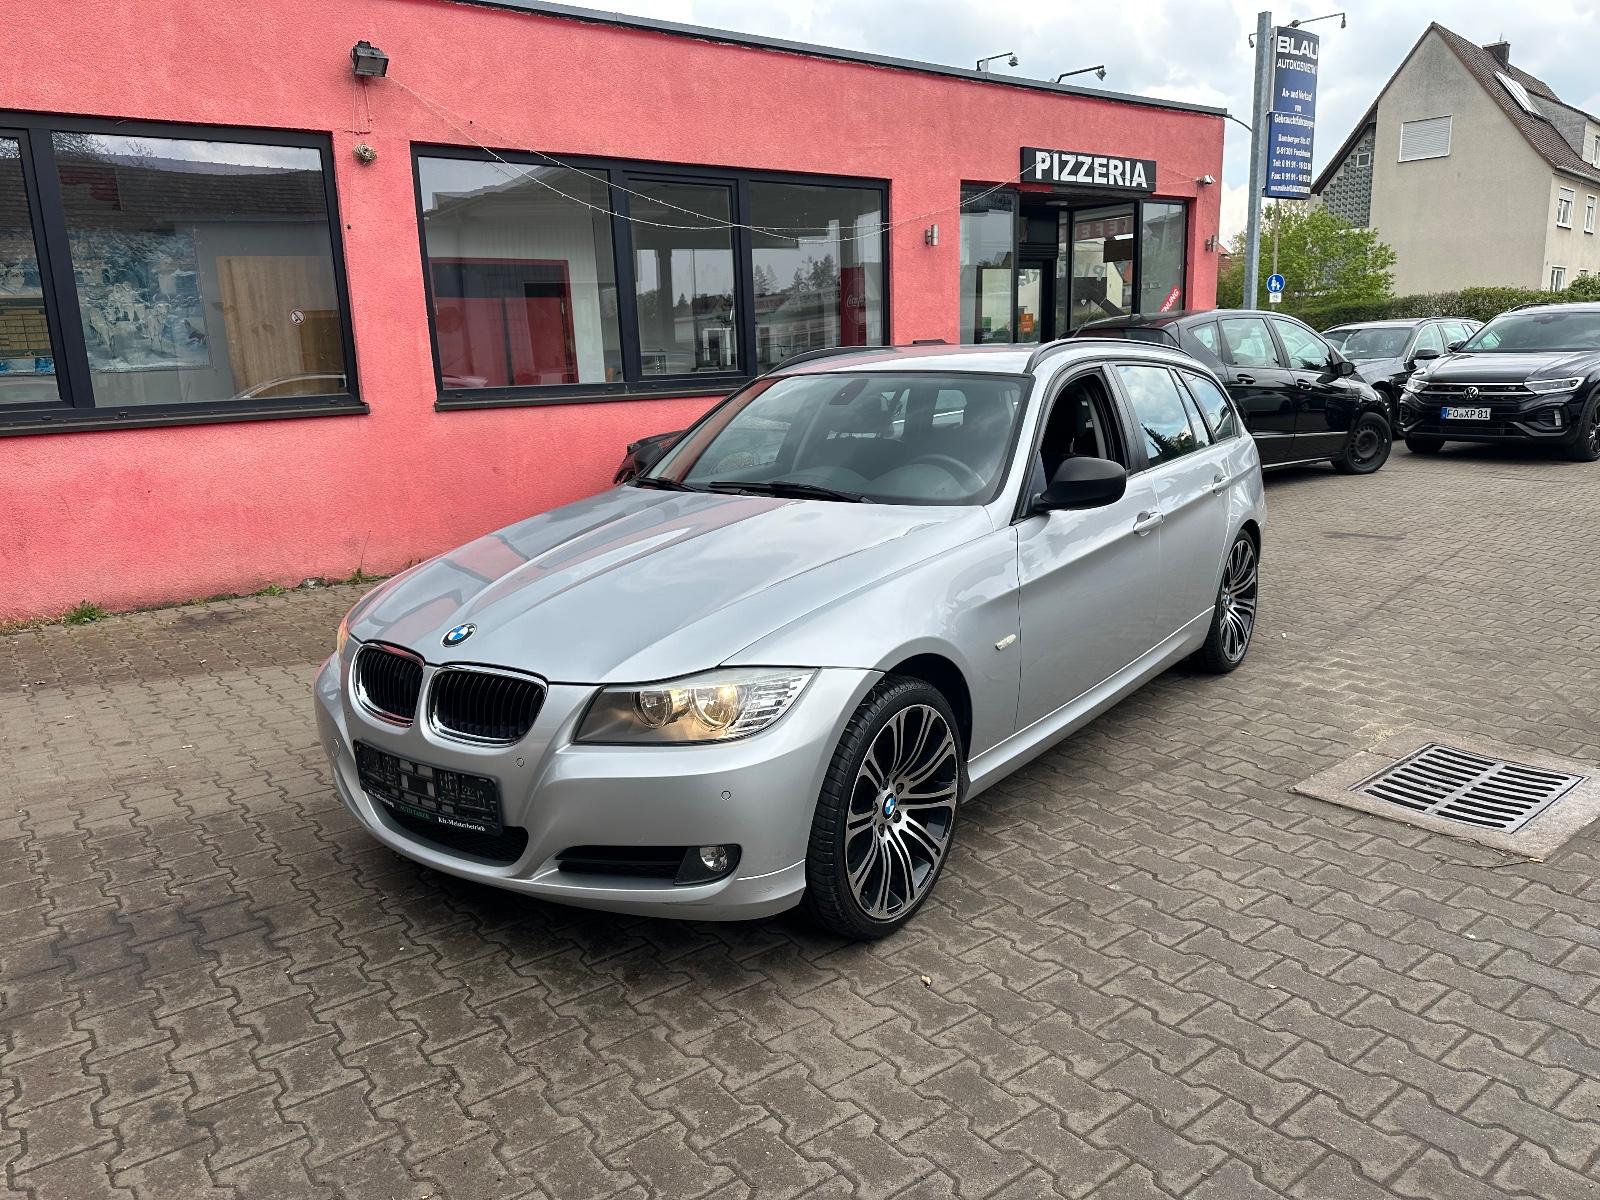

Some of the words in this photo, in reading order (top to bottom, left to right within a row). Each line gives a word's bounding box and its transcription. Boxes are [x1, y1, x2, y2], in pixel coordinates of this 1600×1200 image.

[1277, 36, 1318, 60] BLAU
[1036, 152, 1148, 188] PIZZERIA
[1464, 410, 1476, 418] XP
[1478, 410, 1488, 418] 81
